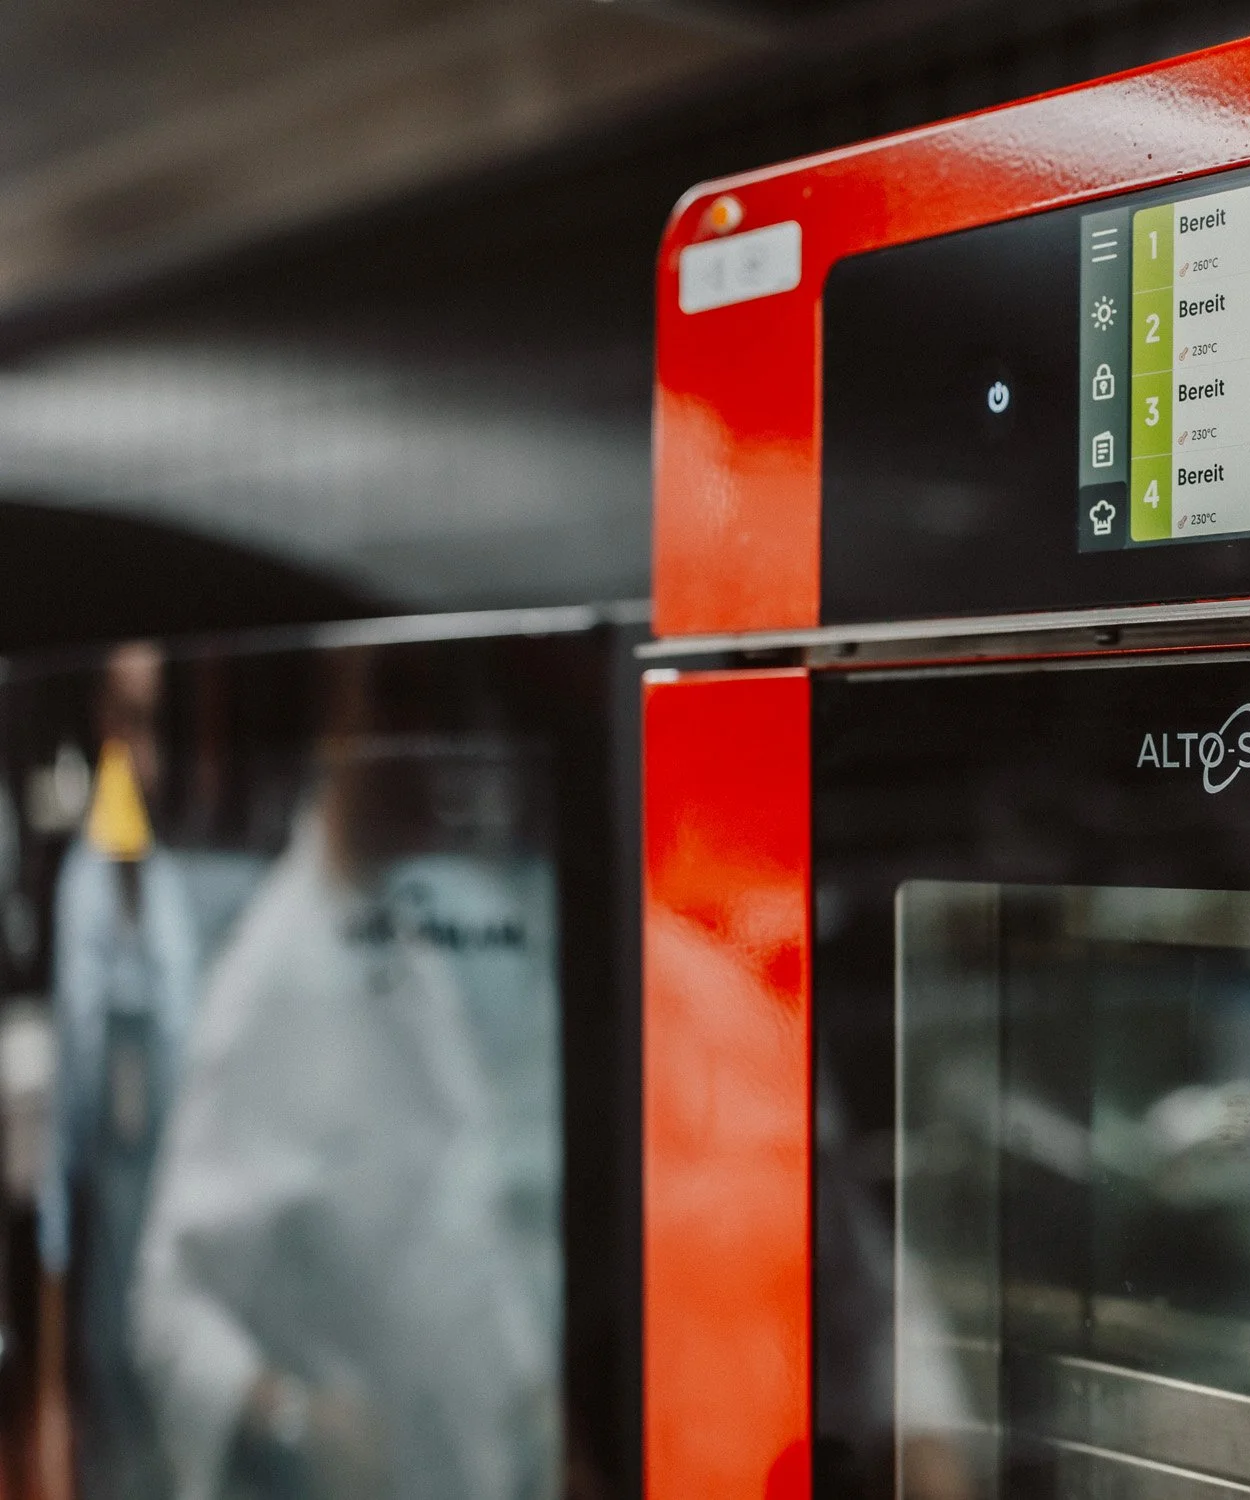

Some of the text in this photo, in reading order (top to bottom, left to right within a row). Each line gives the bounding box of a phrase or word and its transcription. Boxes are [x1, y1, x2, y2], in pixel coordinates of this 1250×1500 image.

[1179, 208, 1226, 234] Bereit
[1148, 230, 1158, 260] 1
[1192, 257, 1218, 272] 260°C
[1178, 293, 1225, 319] Bereit
[1145, 313, 1161, 344] 2
[1191, 342, 1218, 357] 230°C
[1178, 378, 1225, 402] Bereit
[1144, 396, 1160, 427] 3
[1191, 427, 1218, 441] 230°C
[1177, 463, 1225, 486] Bereit
[1142, 479, 1160, 509] 4
[1190, 512, 1217, 525] 230°C
